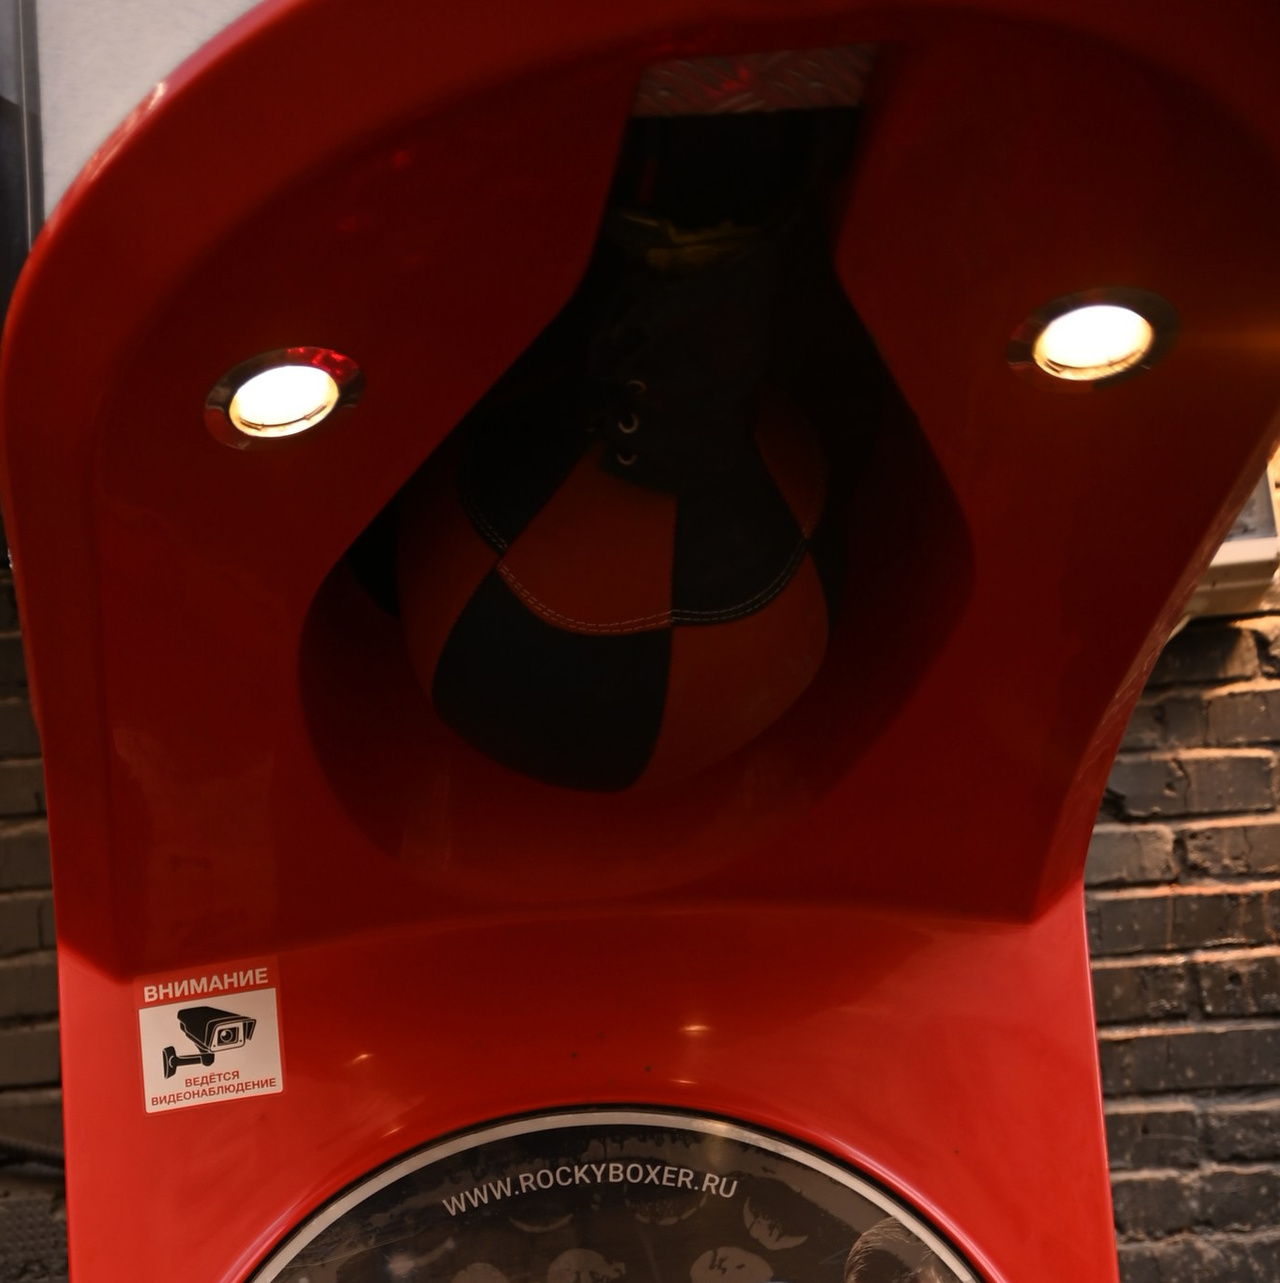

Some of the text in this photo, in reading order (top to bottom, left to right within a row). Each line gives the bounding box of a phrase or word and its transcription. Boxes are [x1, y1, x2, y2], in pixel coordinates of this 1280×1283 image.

[143, 967, 269, 1003] ВНИМАНИЕ
[150, 1077, 277, 1106] ВИДЕОНАБЛЮДЕНИЕ
[184, 1070, 240, 1088] ВЕДЁТСЯ
[441, 1162, 739, 1217] WWW.ROCKYBOXER.RU
